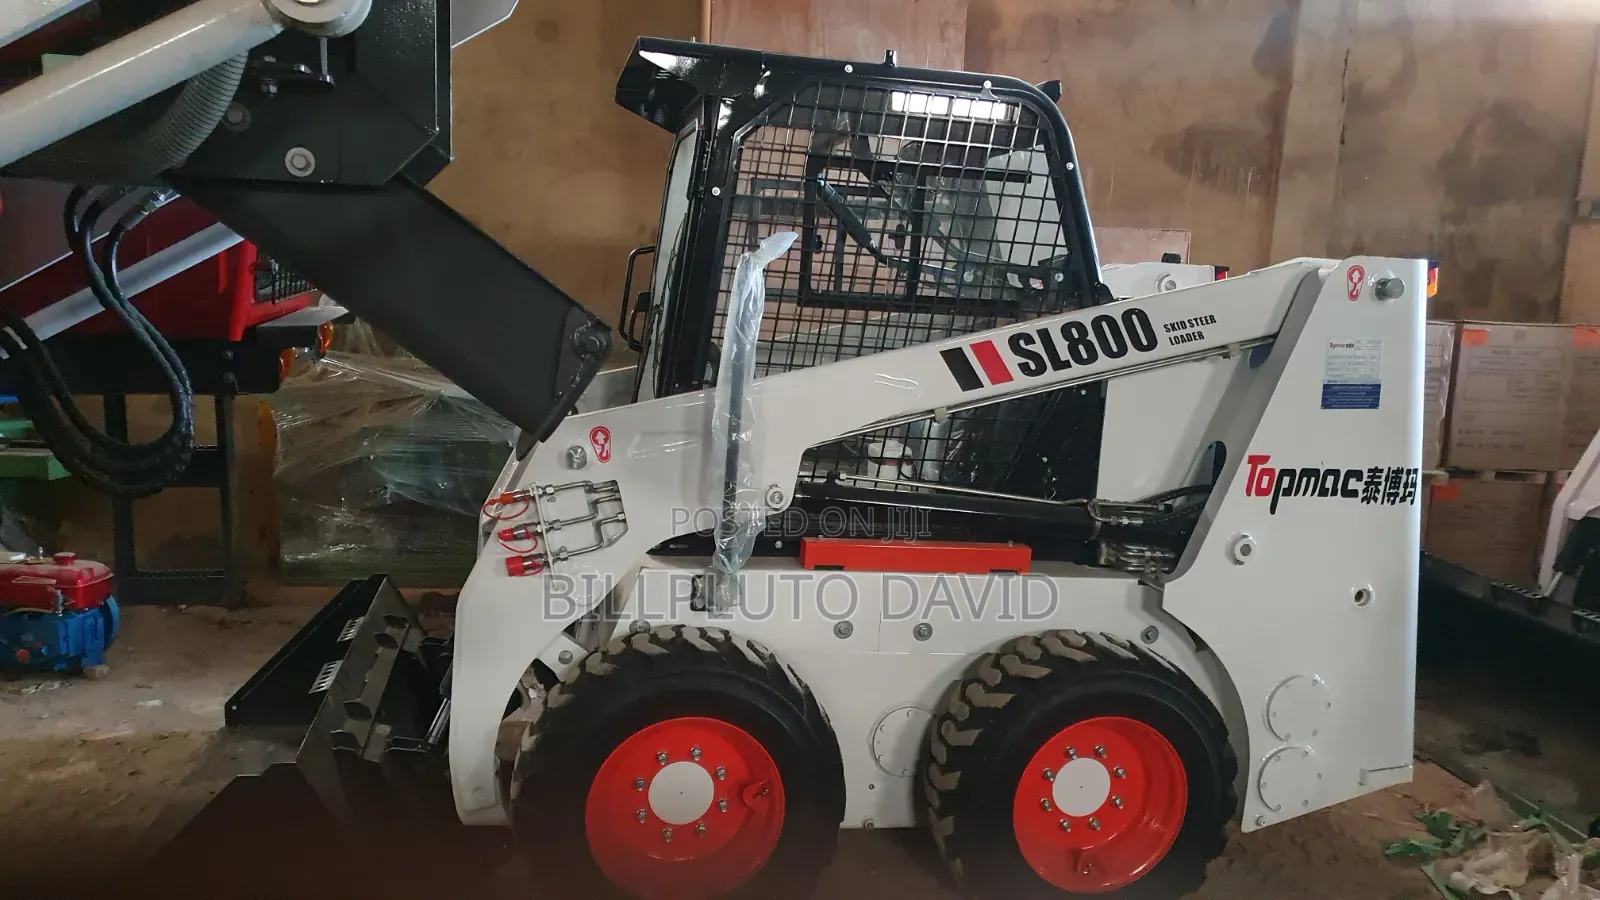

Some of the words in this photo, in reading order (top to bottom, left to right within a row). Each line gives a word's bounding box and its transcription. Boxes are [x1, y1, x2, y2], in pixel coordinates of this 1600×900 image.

[1008, 308, 1158, 377] SL800
[1163, 319, 1188, 334] SKID
[1189, 314, 1217, 329] STEER
[1168, 330, 1205, 346] LOADER
[1245, 454, 1363, 515] Topmac
